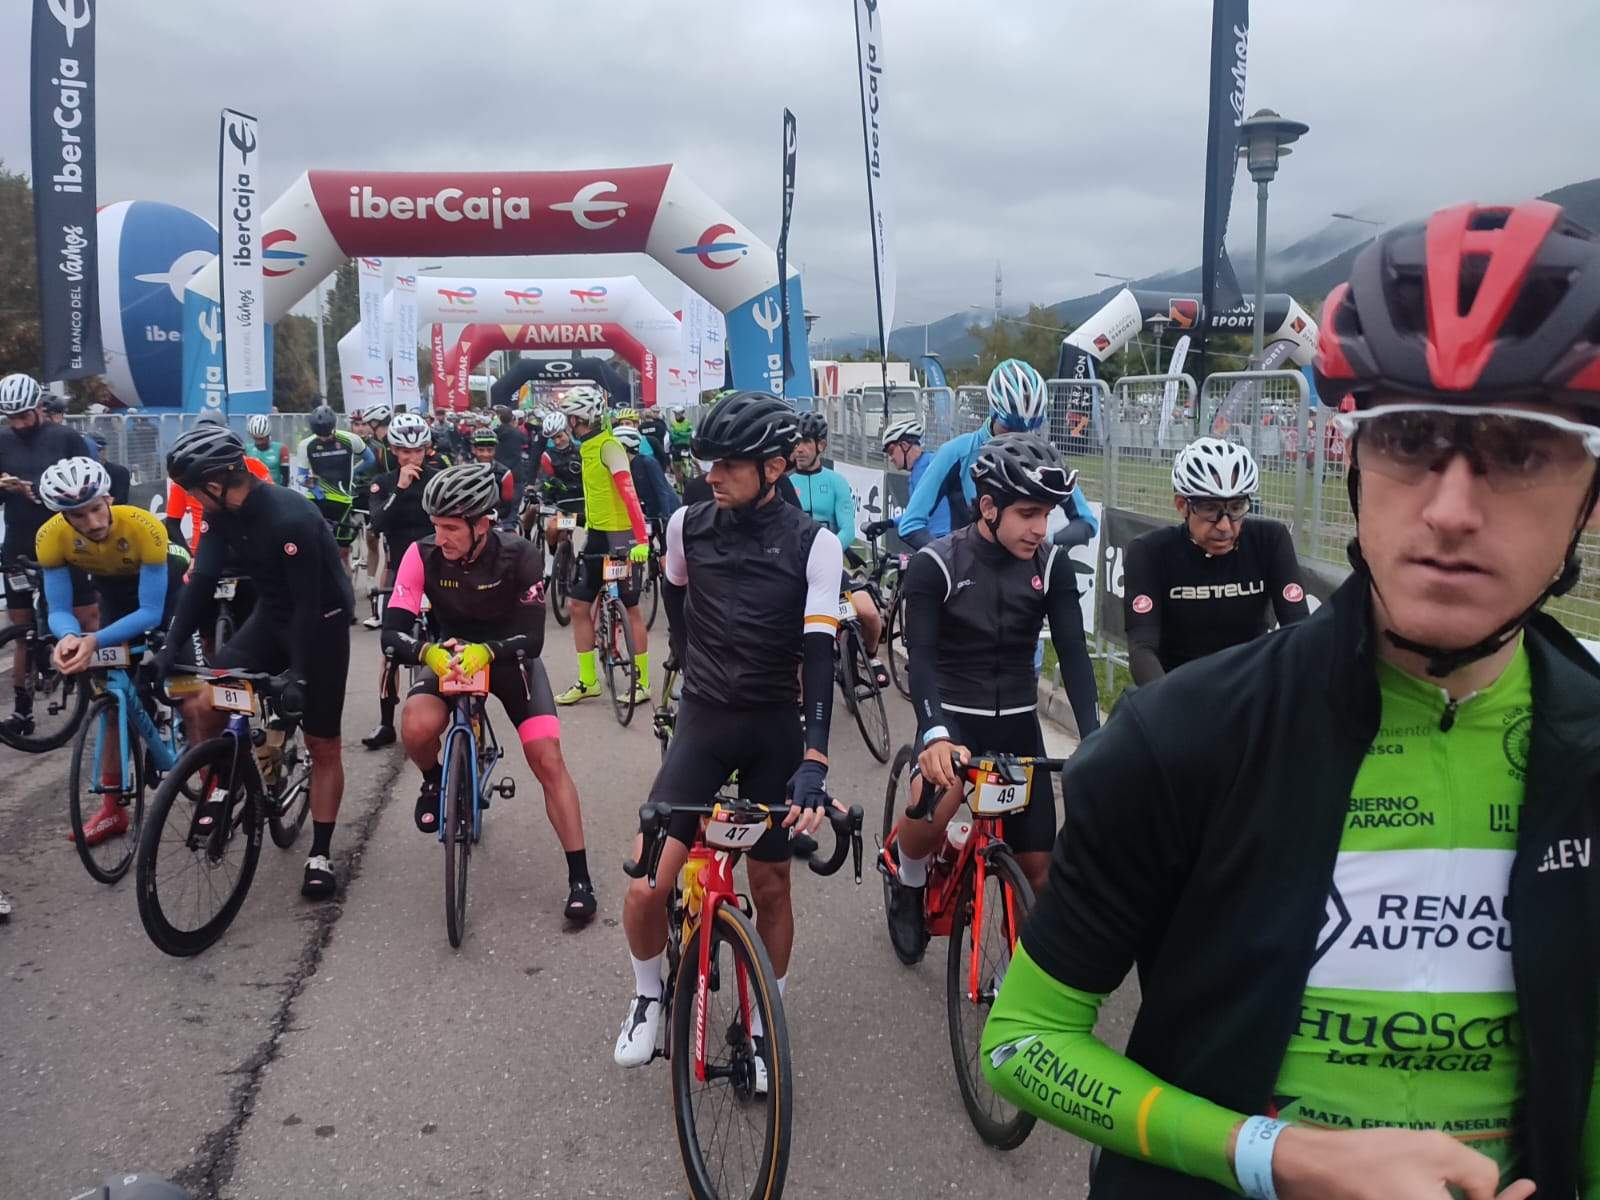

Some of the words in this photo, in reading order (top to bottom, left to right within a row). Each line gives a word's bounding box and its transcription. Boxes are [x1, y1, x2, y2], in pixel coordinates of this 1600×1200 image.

[52, 58, 88, 193] iberCaja
[867, 43, 882, 179] iberCaja
[232, 173, 255, 267] iberCaja
[349, 185, 530, 230] iberCaja
[59, 224, 88, 281] Vamos
[71, 286, 82, 308] DEL
[71, 311, 82, 352] BANCO
[524, 324, 607, 343] AMBAR
[72, 356, 82, 369] EL
[436, 335, 446, 381] AMBAR
[458, 355, 469, 395] AMBAR
[96, 649, 117, 662] 153
[225, 689, 238, 703] 81
[997, 787, 1015, 804] 49
[725, 827, 749, 841] 47
[1350, 812, 1434, 829] ARAGON
[1350, 924, 1459, 950] AUTO
[1024, 1040, 1121, 1109] RENAULT
[1013, 1065, 1049, 1102] AUTO
[1051, 1091, 1114, 1130] CUATRO
[1299, 1105, 1353, 1128] MATA
